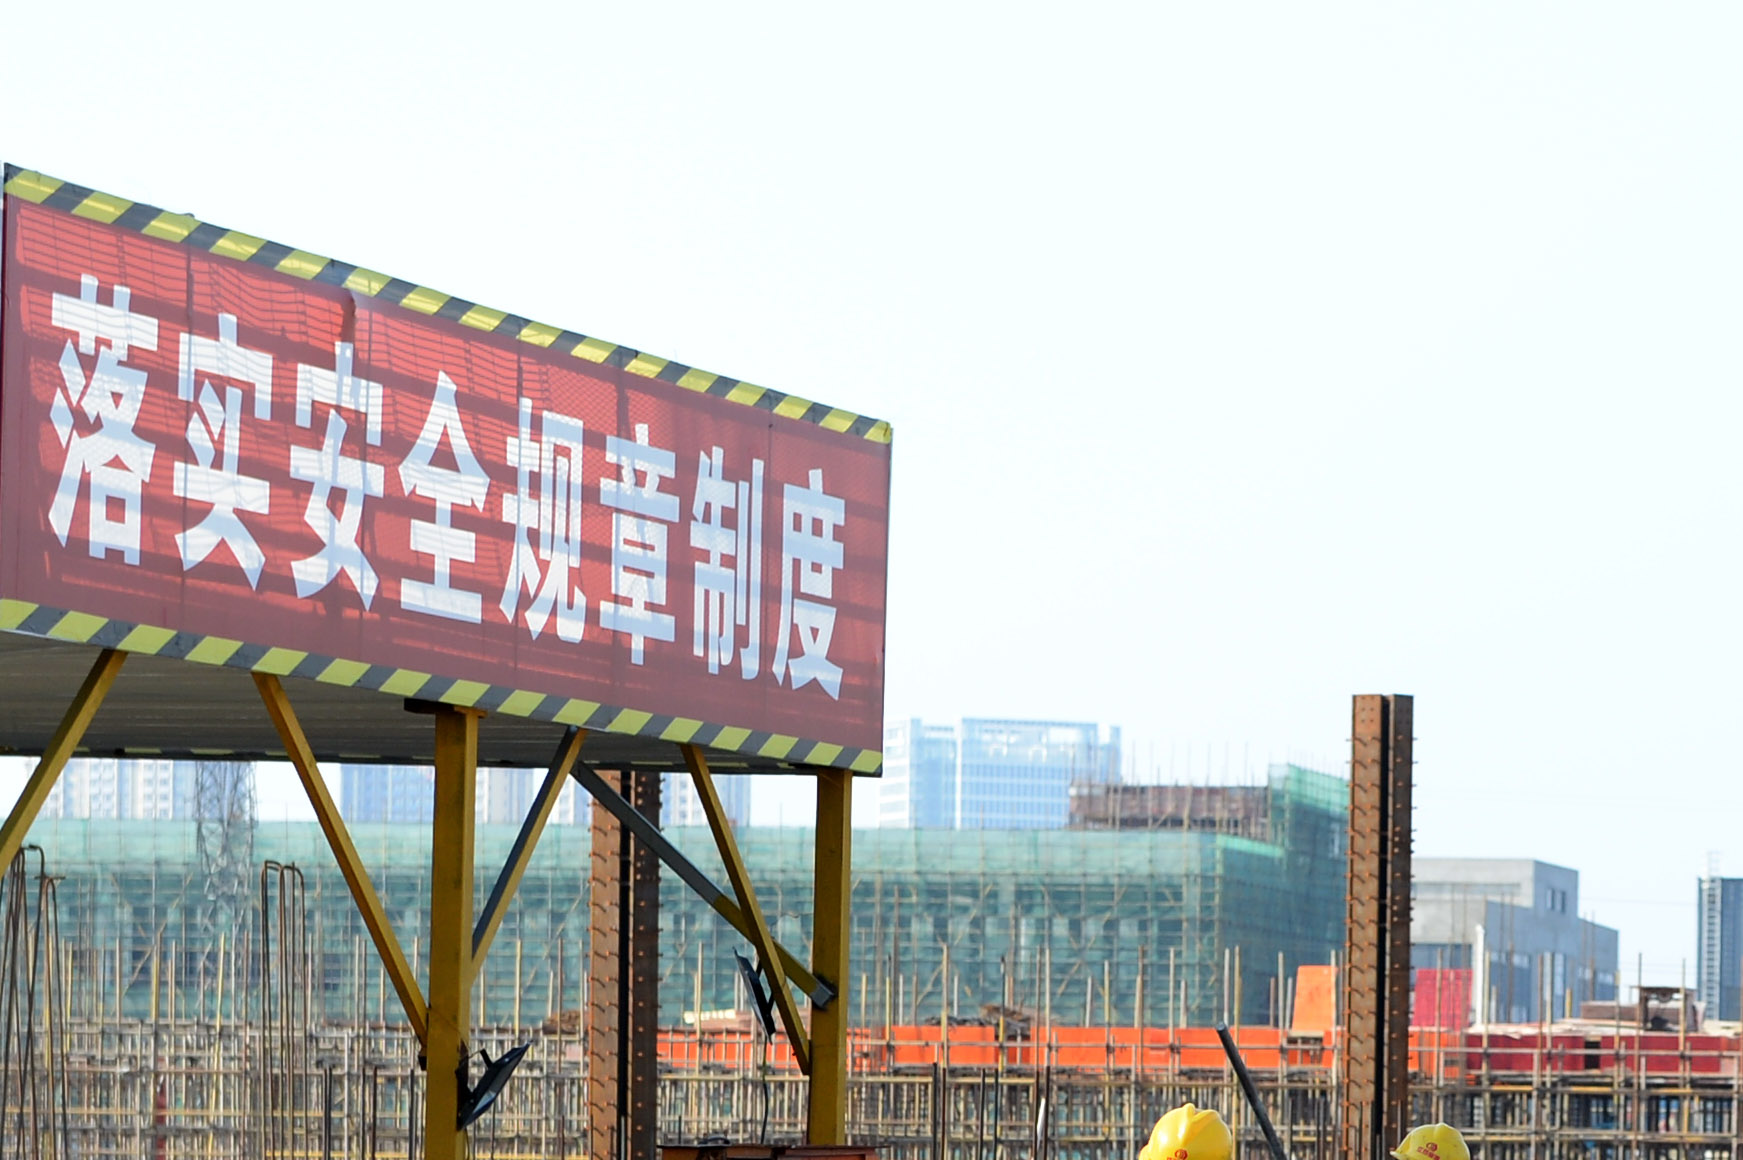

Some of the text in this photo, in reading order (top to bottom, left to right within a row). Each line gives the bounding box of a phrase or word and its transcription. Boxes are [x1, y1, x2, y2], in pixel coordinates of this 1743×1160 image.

[48, 273, 845, 701] 落实安全规章制度
